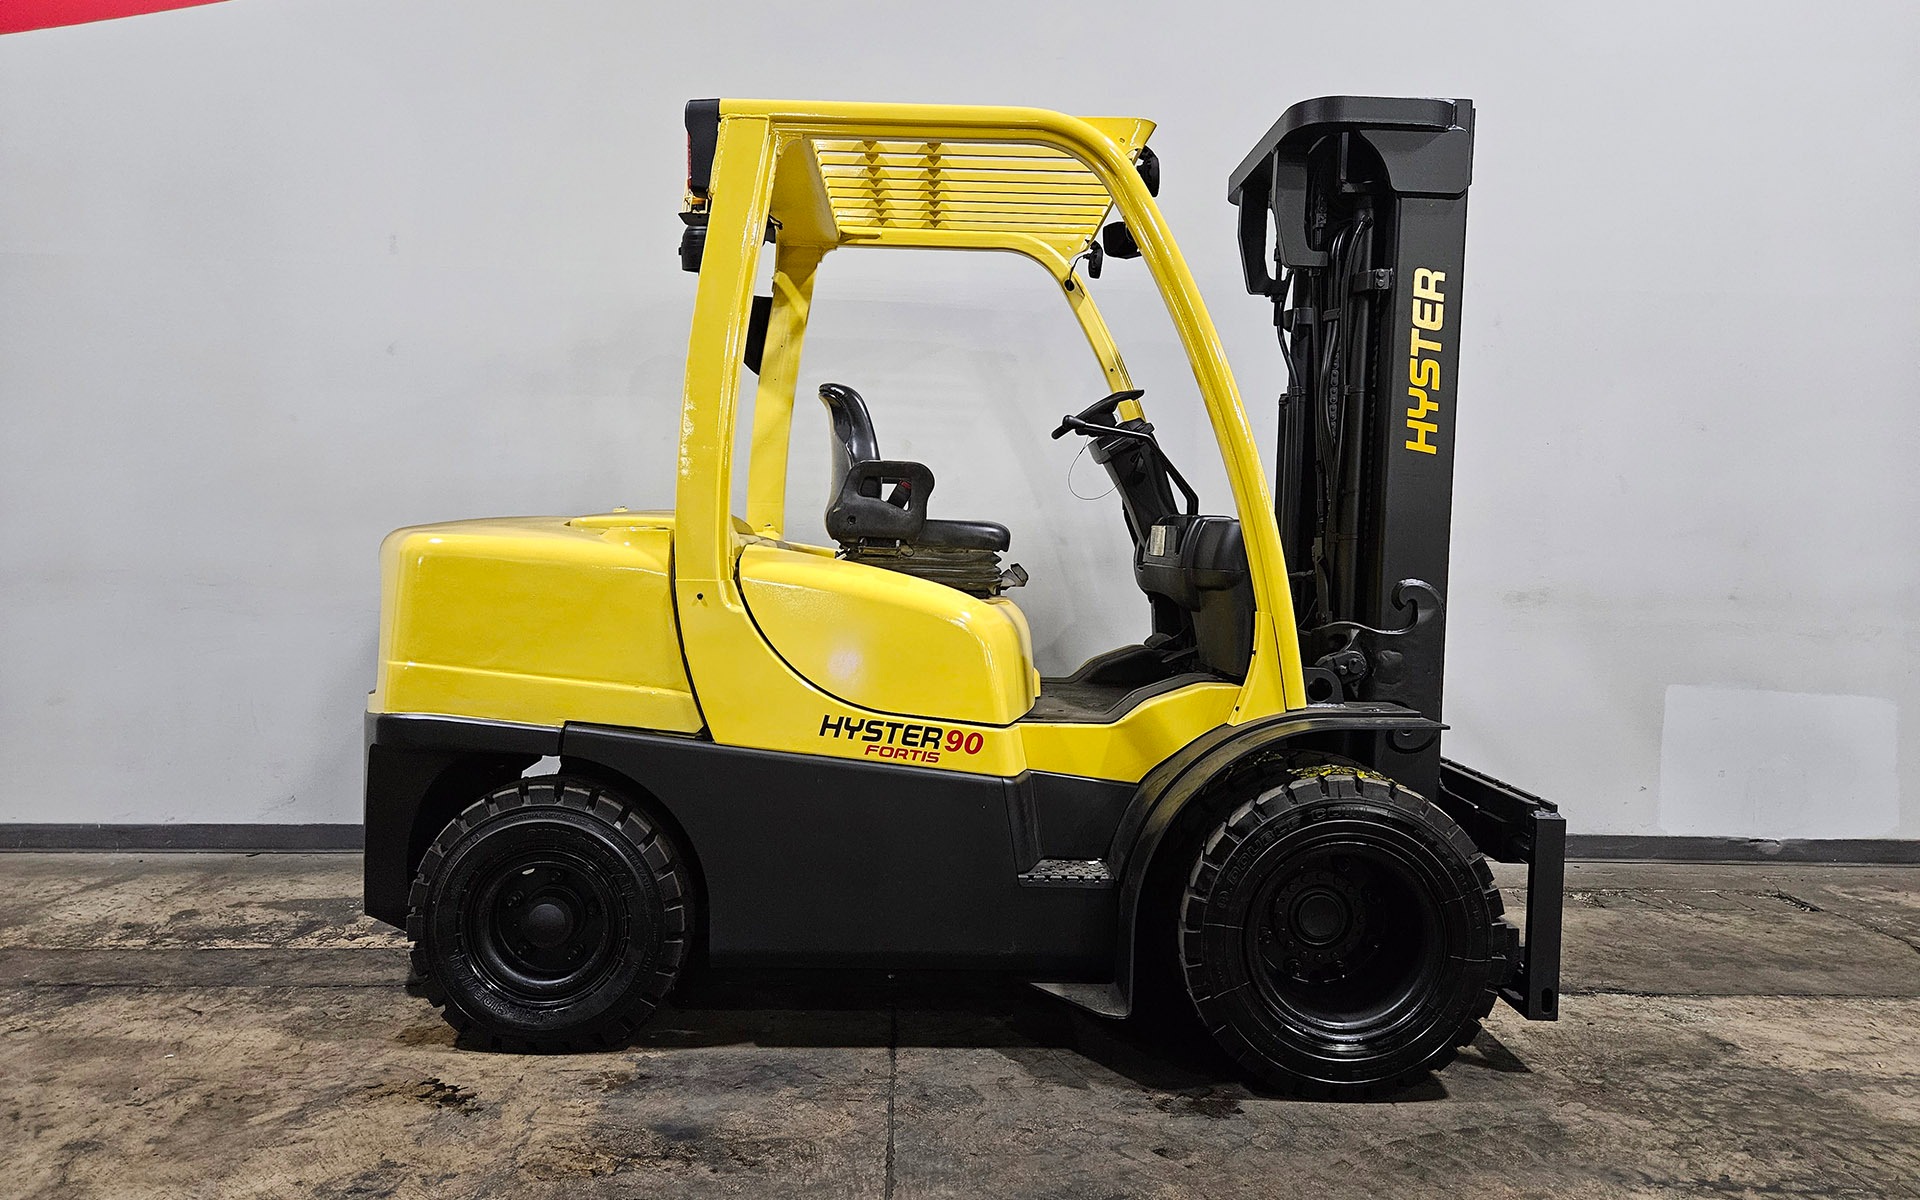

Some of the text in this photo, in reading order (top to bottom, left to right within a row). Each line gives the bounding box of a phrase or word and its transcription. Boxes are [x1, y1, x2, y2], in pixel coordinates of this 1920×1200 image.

[1405, 267, 1446, 455] HYSTER
[819, 715, 984, 755] HYSTER 90
[865, 745, 941, 764] FORTIS
